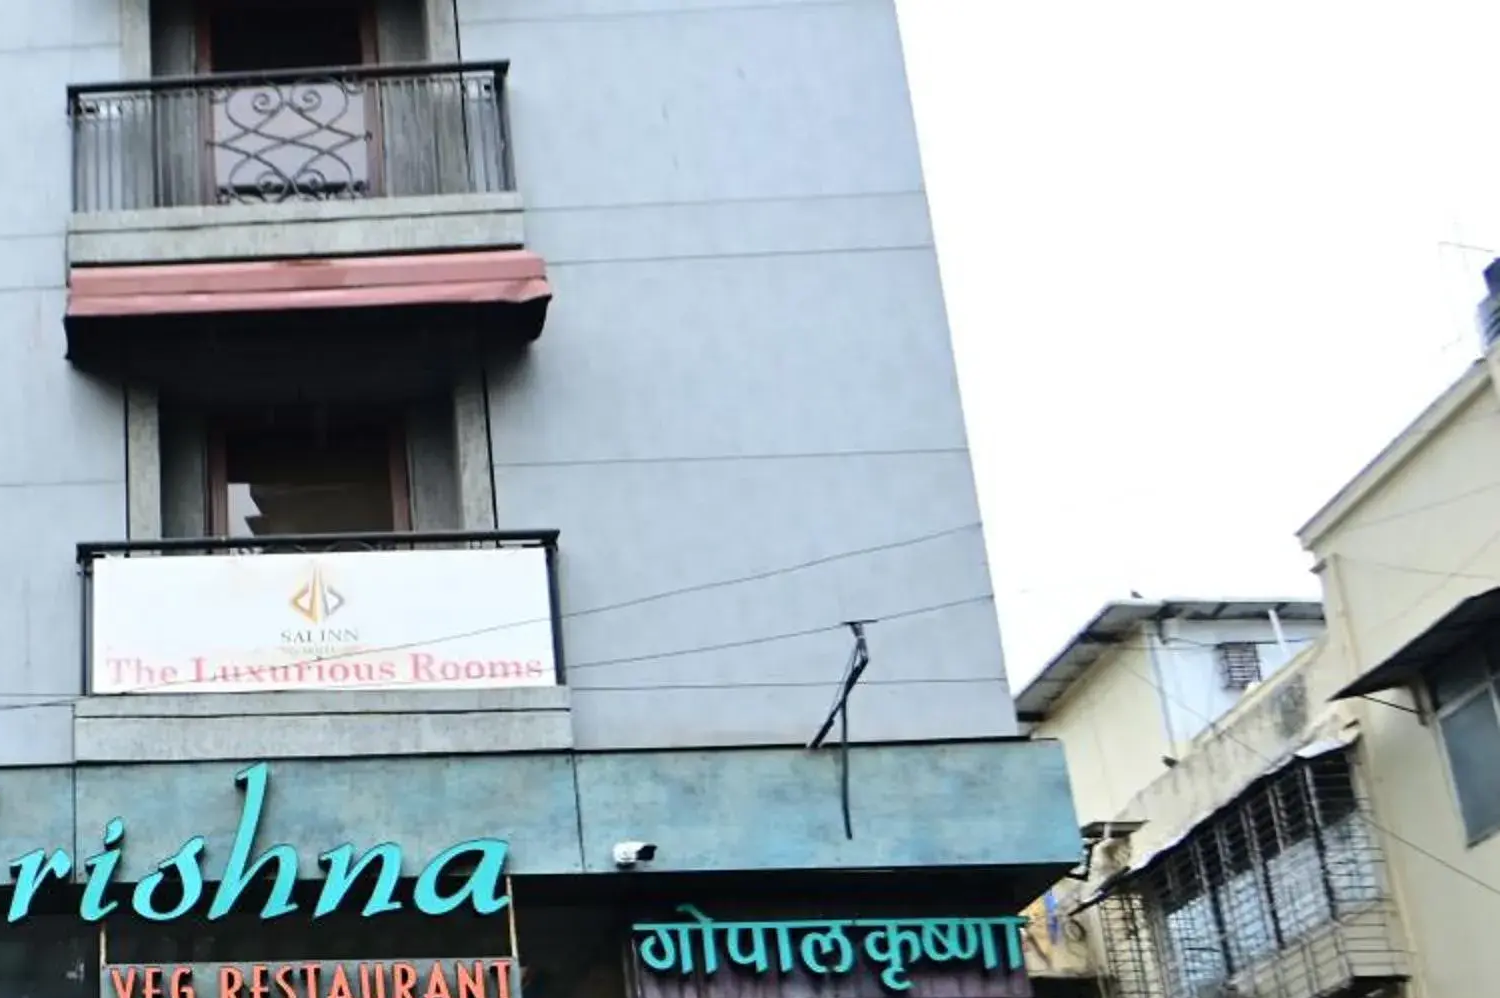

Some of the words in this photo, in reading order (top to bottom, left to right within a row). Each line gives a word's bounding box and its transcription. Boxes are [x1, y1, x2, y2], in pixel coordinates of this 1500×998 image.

[320, 626, 360, 643] INN
[106, 656, 178, 686] The
[193, 655, 396, 685] Luxurious
[409, 652, 544, 682] Rooms
[632, 904, 853, 976] गोपाल
[855, 914, 1030, 991] कृष्णा
